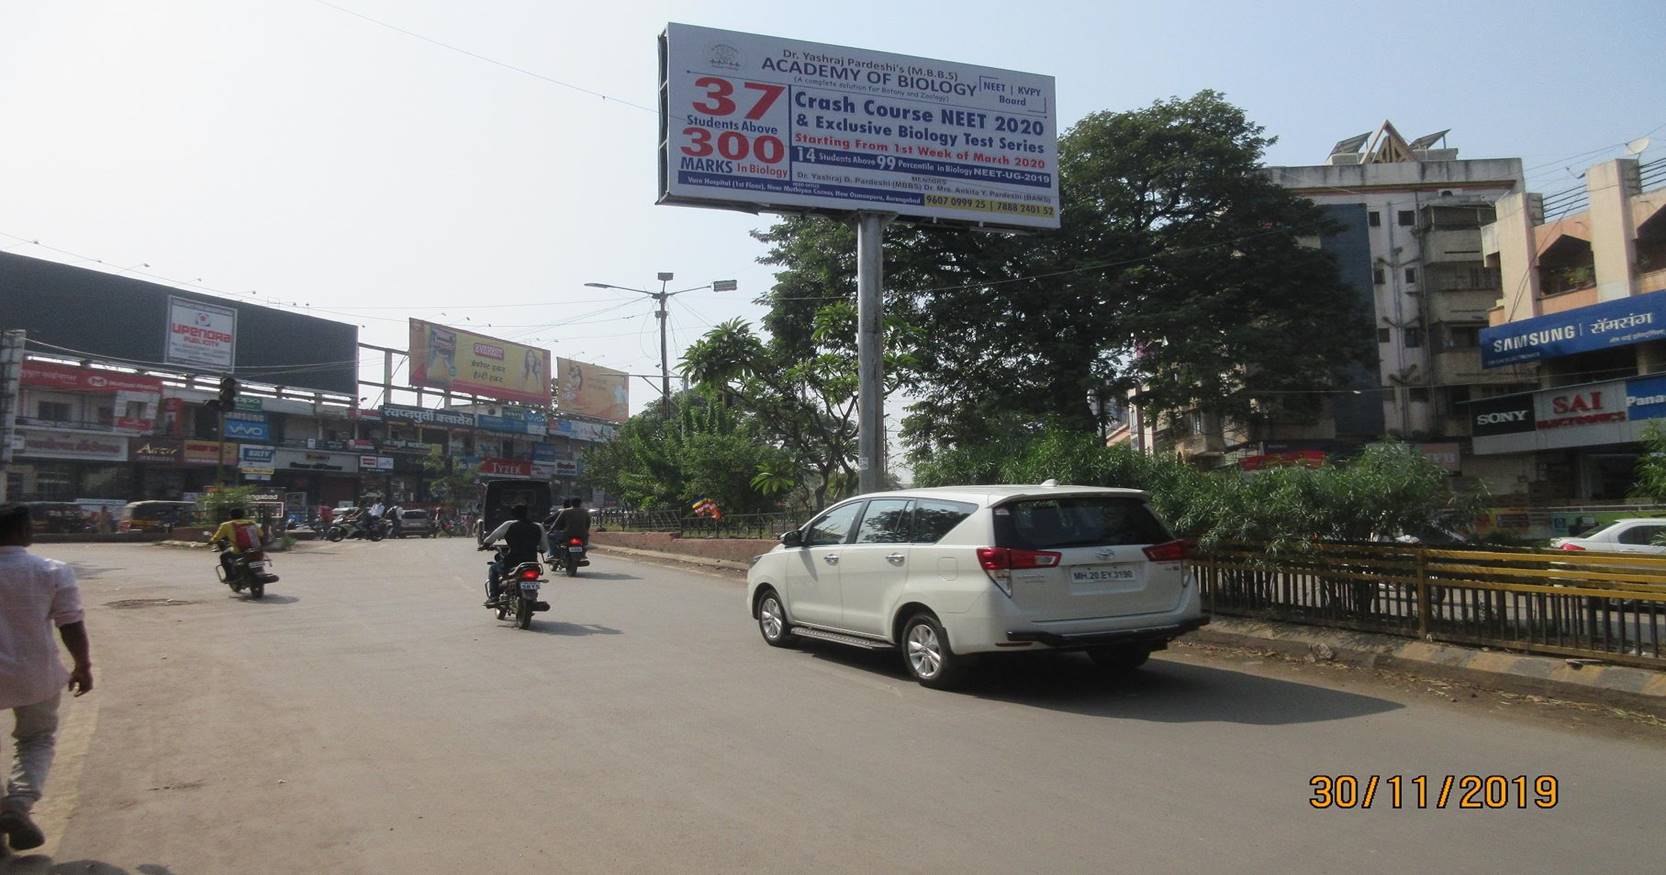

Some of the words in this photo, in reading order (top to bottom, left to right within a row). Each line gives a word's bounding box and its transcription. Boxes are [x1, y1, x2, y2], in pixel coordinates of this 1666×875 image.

[761, 57, 861, 82] ACADEMY
[867, 71, 892, 86] OF
[898, 75, 977, 97] BIOLOGY
[783, 49, 799, 59] Dr.
[802, 52, 845, 67] Yashraj
[848, 58, 904, 76] Pardeshi's
[907, 66, 959, 82] (M.B.B.S)
[692, 76, 786, 121] 37
[984, 81, 1006, 92] NEET
[1017, 86, 1041, 97] KVPY
[999, 96, 1026, 106] Board
[687, 115, 739, 131] Students
[741, 121, 778, 135] Above
[795, 91, 856, 114] Crash
[863, 99, 933, 123] Course
[941, 109, 987, 130] NEET
[995, 115, 1044, 136] 2020
[680, 127, 785, 164] 300
[796, 113, 808, 127] &
[816, 115, 892, 136] Exclusive
[898, 125, 958, 147] Biology
[963, 132, 994, 148] Test
[999, 137, 1045, 154] Series
[795, 133, 850, 150] Starting
[855, 137, 888, 152] From
[894, 144, 913, 155] 1st
[918, 146, 951, 159] Week
[956, 152, 969, 161] of
[973, 153, 1010, 165] March
[1015, 157, 1046, 169] 2020
[680, 157, 733, 174] MARKS
[737, 163, 747, 173] In
[749, 165, 788, 179] Biology
[798, 147, 817, 163] 14
[819, 152, 852, 164] Students
[853, 155, 876, 166] Above
[876, 155, 897, 170] 99
[899, 159, 935, 171] Percentile
[945, 165, 973, 177] Biology
[973, 169, 1050, 184] NEET-UG-2019
[926, 195, 948, 205] 9607
[950, 197, 973, 208] 0999
[975, 200, 986, 209] 25
[997, 201, 1018, 212] 7888
[1020, 204, 1041, 214] 2401
[1043, 206, 1054, 216] 52
[1493, 325, 1576, 353] SAMSUNG
[1552, 391, 1603, 415] SAI
[1626, 394, 1666, 407] Pana
[1477, 410, 1529, 425] SONY
